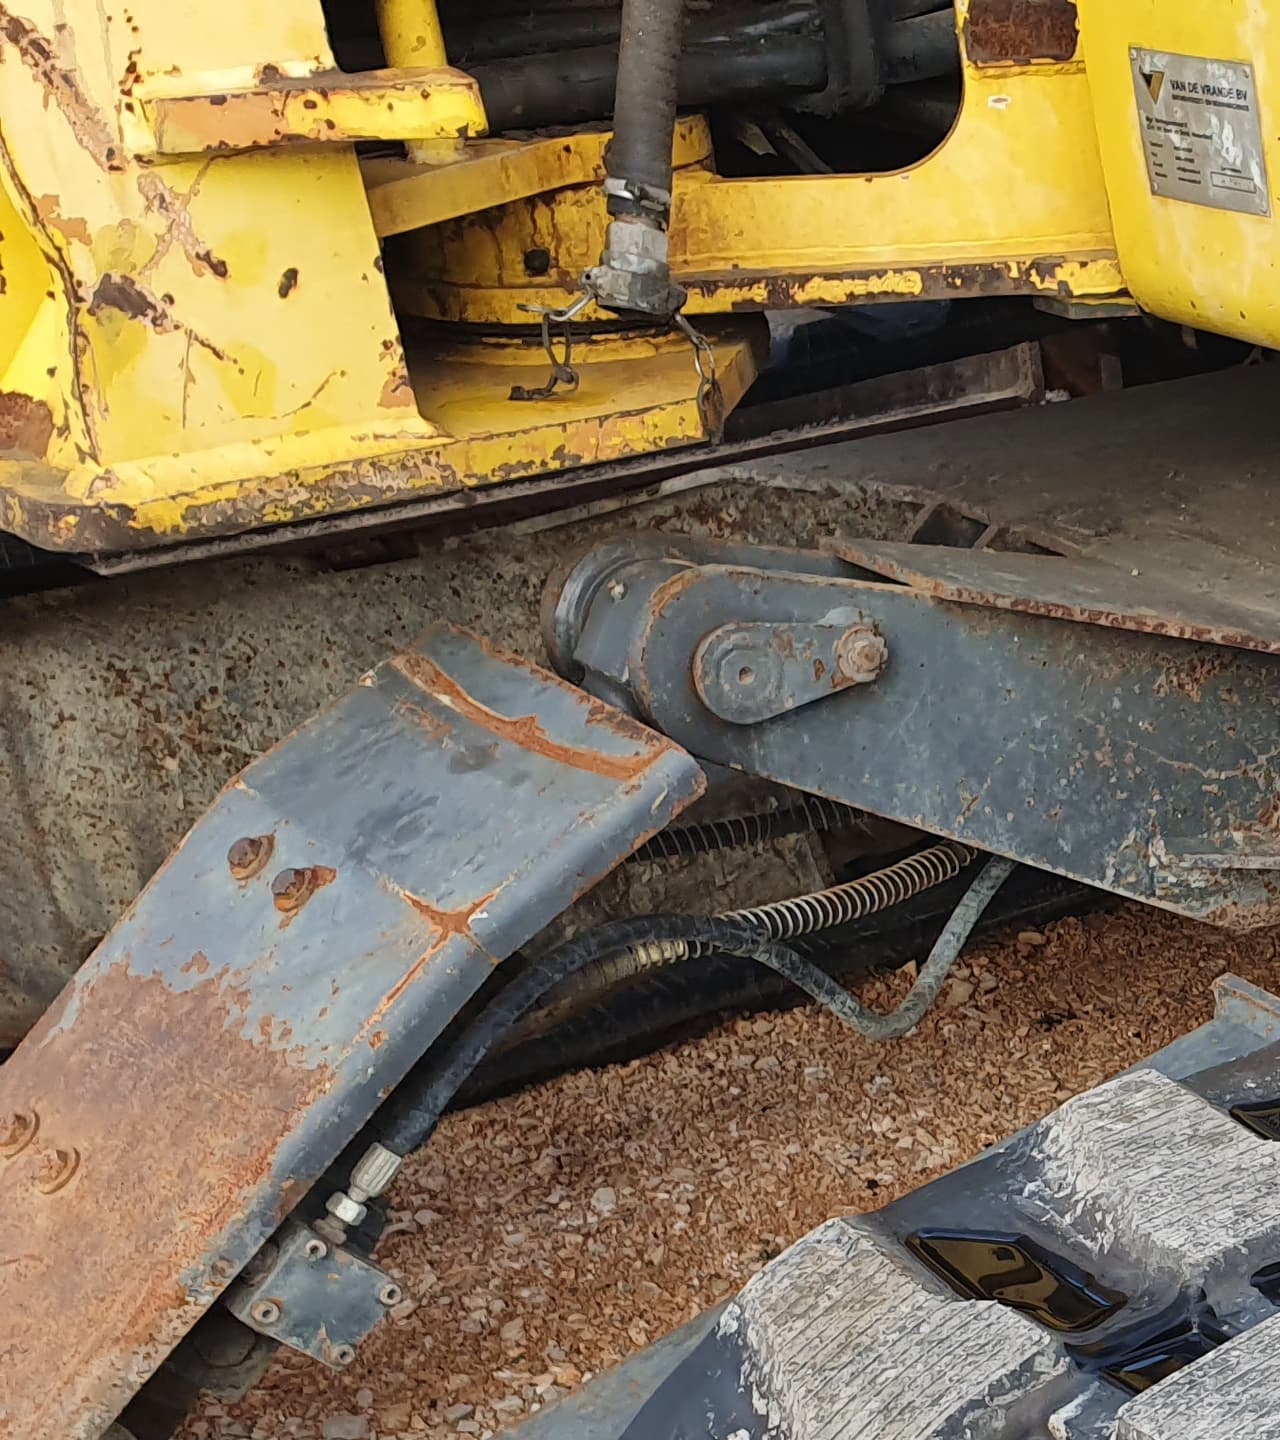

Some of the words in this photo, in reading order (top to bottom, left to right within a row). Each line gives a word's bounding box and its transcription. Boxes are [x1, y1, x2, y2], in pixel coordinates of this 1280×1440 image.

[1170, 80, 1186, 92] VAN
[1187, 83, 1199, 94] DE
[1236, 88, 1248, 101] BV
